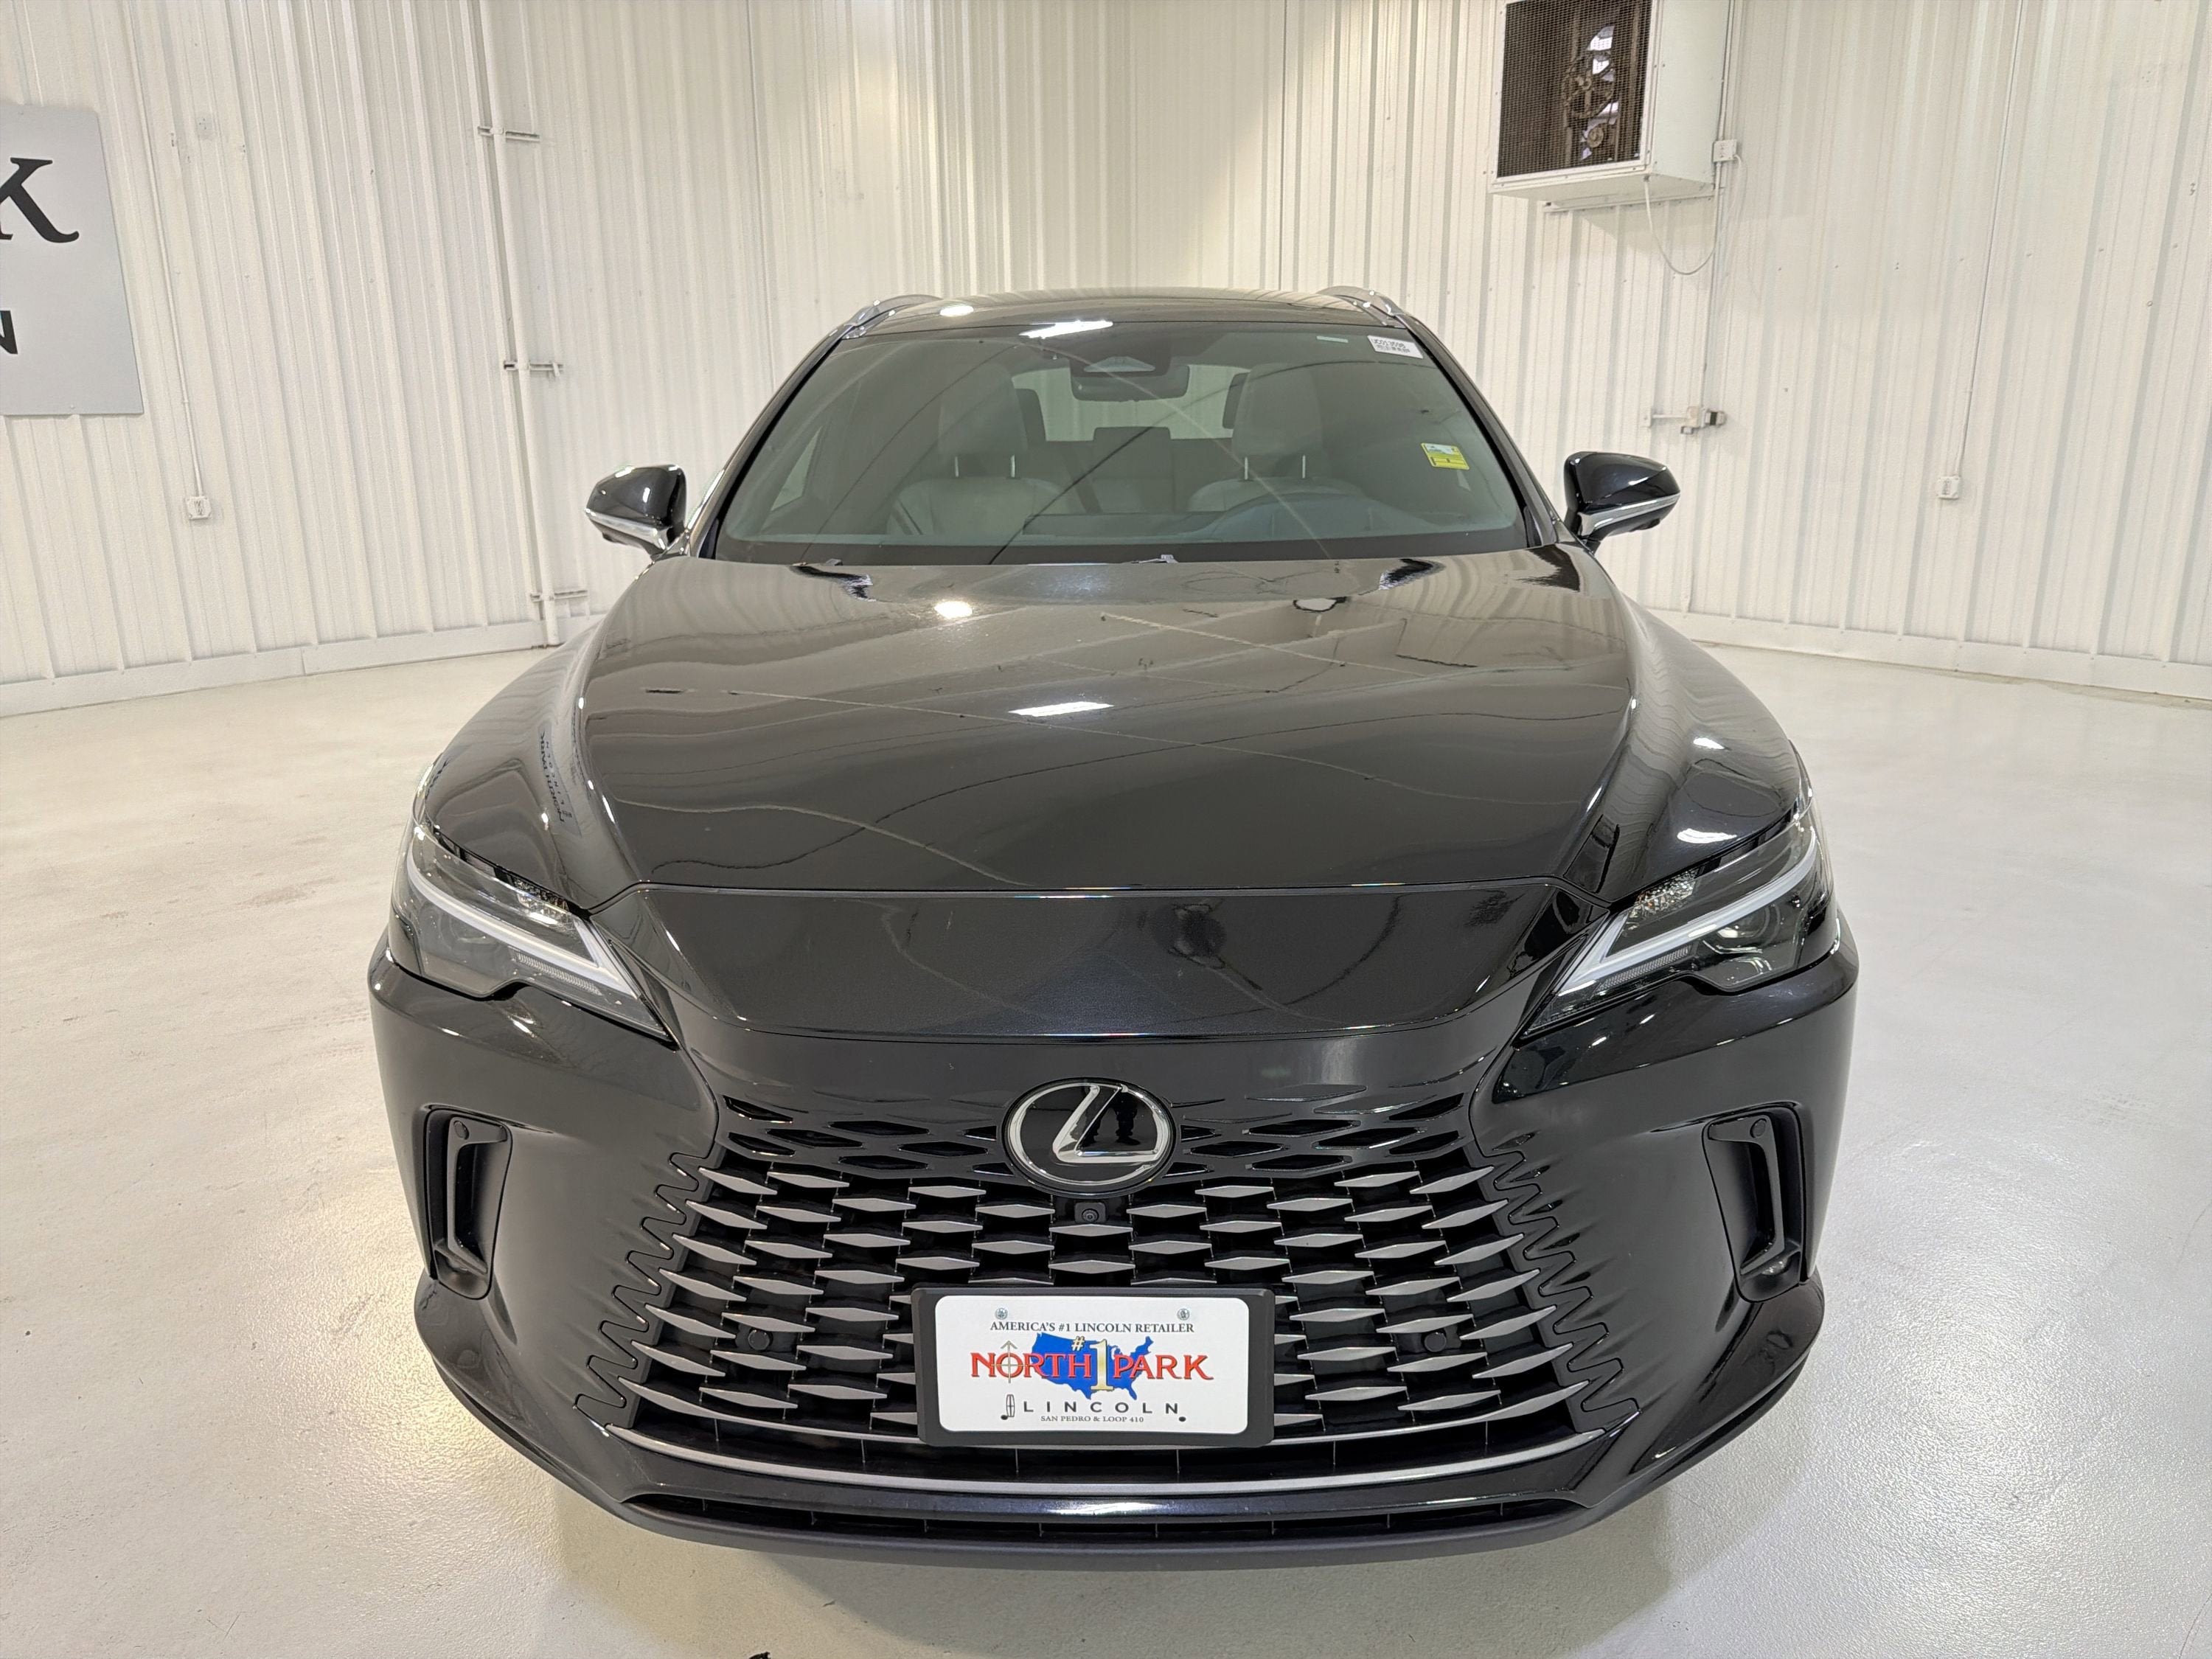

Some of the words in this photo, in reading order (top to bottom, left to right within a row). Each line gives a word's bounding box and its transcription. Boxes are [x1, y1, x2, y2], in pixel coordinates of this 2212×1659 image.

[990, 1321, 1056, 1332] AMERICA'S
[1058, 1324, 1071, 1332] #1
[1074, 1323, 1132, 1333] LINCOLN
[1135, 1323, 1194, 1333] RETAILER
[970, 1352, 1092, 1378] NORTH
[1113, 1354, 1214, 1380] PARK
[1023, 1401, 1178, 1414] LINCOLN
